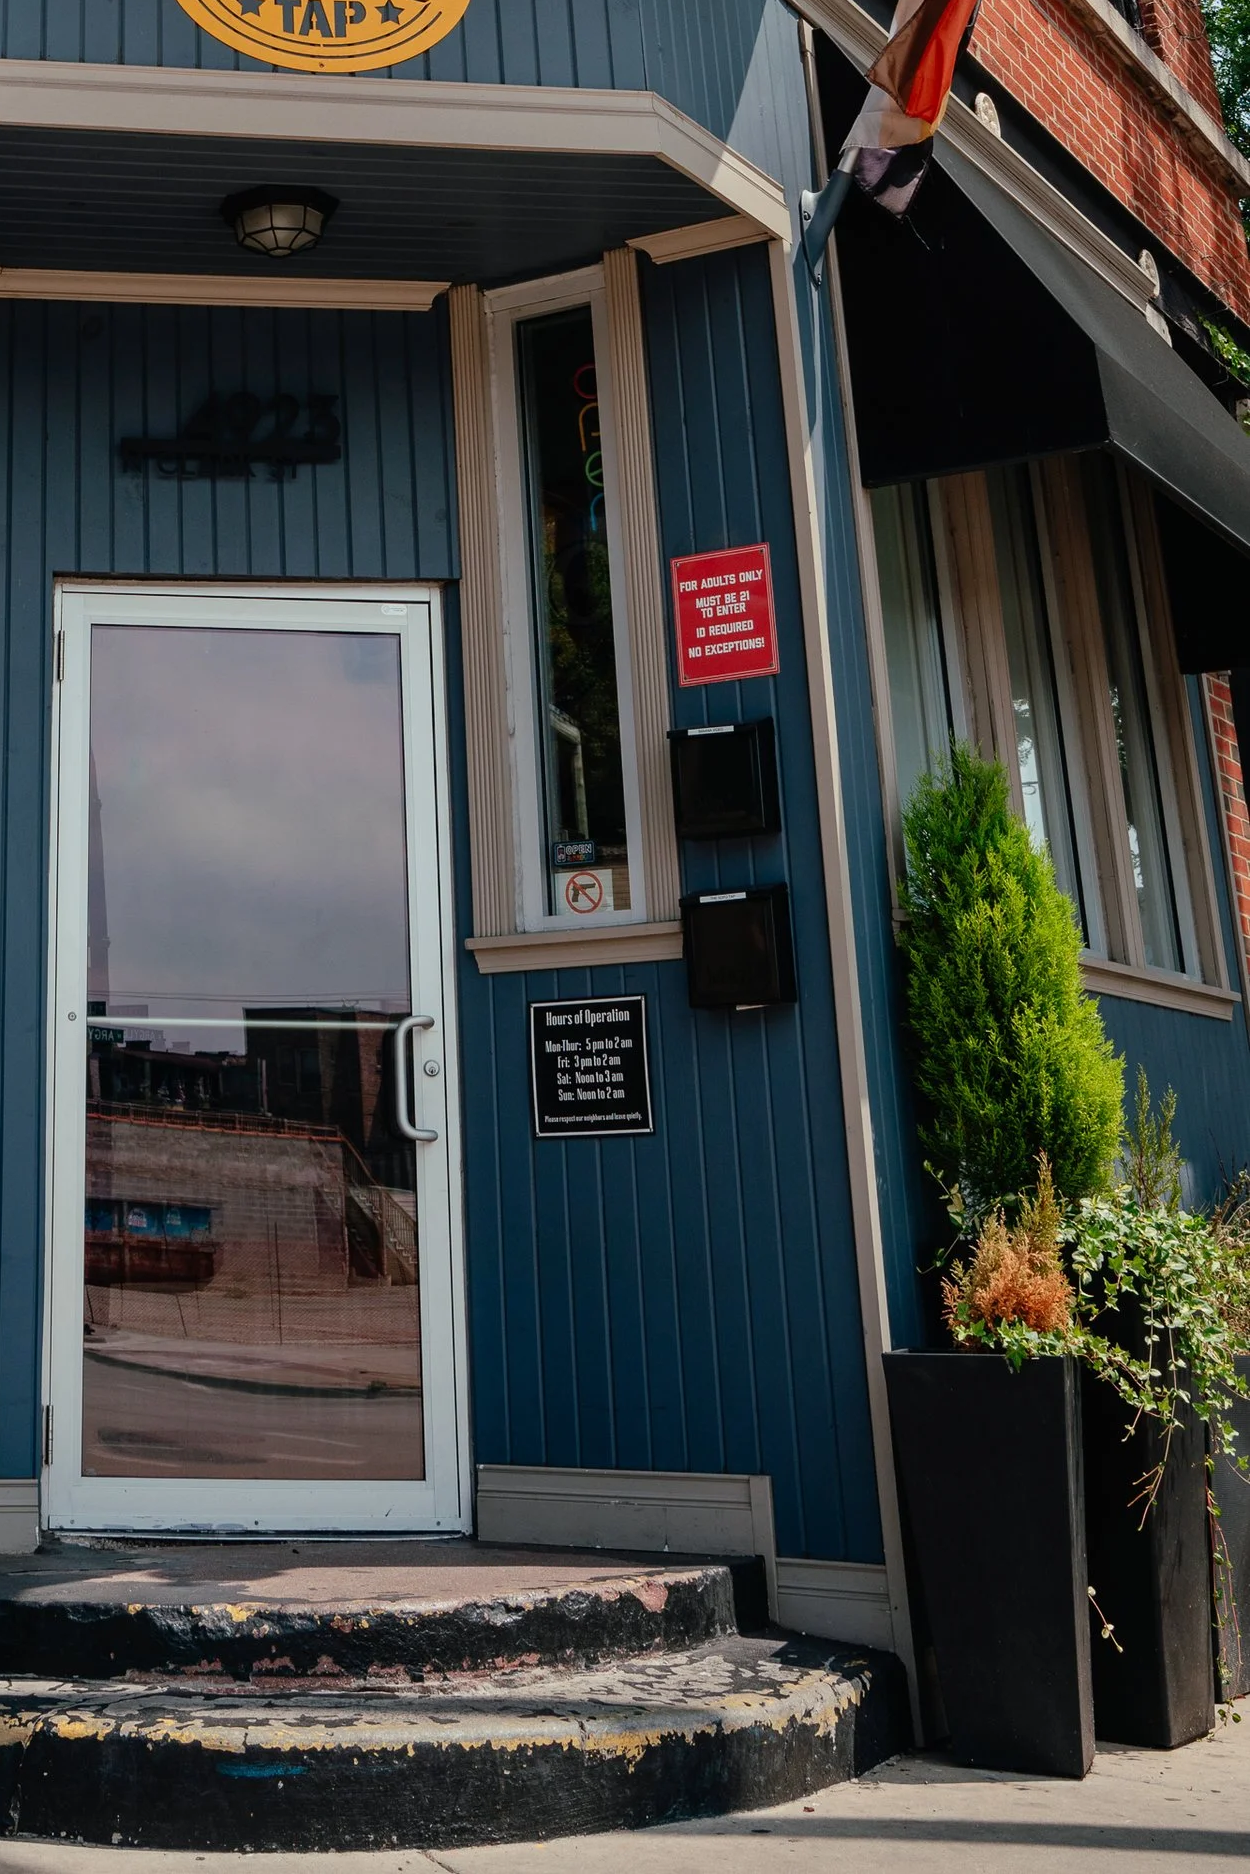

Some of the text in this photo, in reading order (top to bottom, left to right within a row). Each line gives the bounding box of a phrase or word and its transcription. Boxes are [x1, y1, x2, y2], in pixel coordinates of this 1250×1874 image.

[679, 569, 763, 593] FOR ADULTS ONLY
[696, 590, 750, 609] MUST BE 21
[701, 602, 747, 619] TO ENTER
[696, 620, 754, 638] ID REQUIRED
[688, 637, 765, 659] NO EXCEPTIONS!
[565, 843, 593, 855] OPEN
[545, 1008, 630, 1027] Hours of Operation
[545, 1036, 633, 1053] Mon-Thur: 5 pm to 2 am
[557, 1054, 621, 1070] Fri: 3 pm to 2 am
[557, 1070, 624, 1085] Sat: Noon to 3 am
[558, 1086, 625, 1102] Sun: Noon to 2 am
